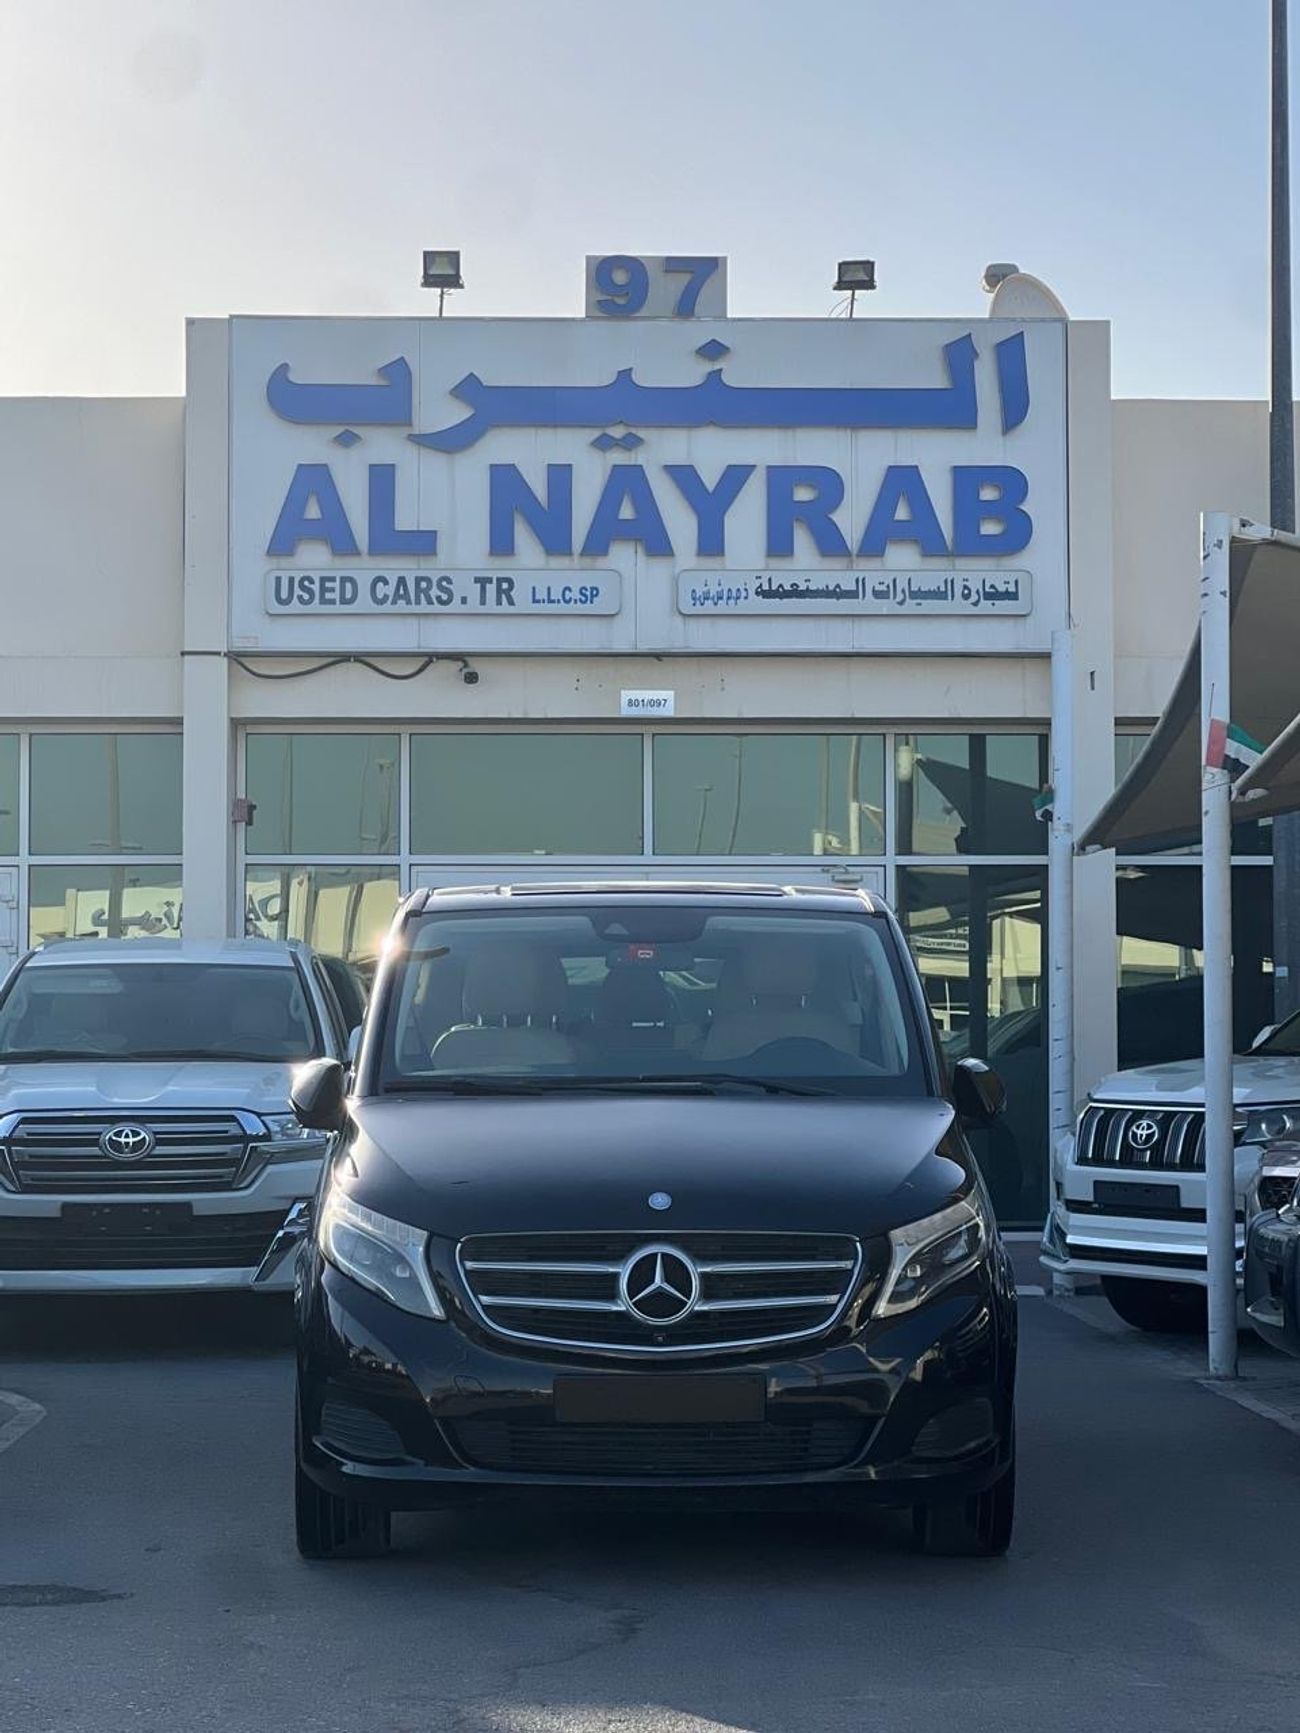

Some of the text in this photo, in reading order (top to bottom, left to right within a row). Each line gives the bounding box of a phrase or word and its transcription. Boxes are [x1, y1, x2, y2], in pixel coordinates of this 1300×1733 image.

[595, 255, 719, 316] 97
[267, 331, 1030, 454] النيرب
[266, 464, 1033, 557] AL NAYRAB
[274, 575, 359, 606] USED
[755, 575, 866, 601] المستعملة
[871, 576, 955, 606] السيارات
[961, 577, 1019, 607] لتجارة
[627, 698, 667, 708] 801/097
